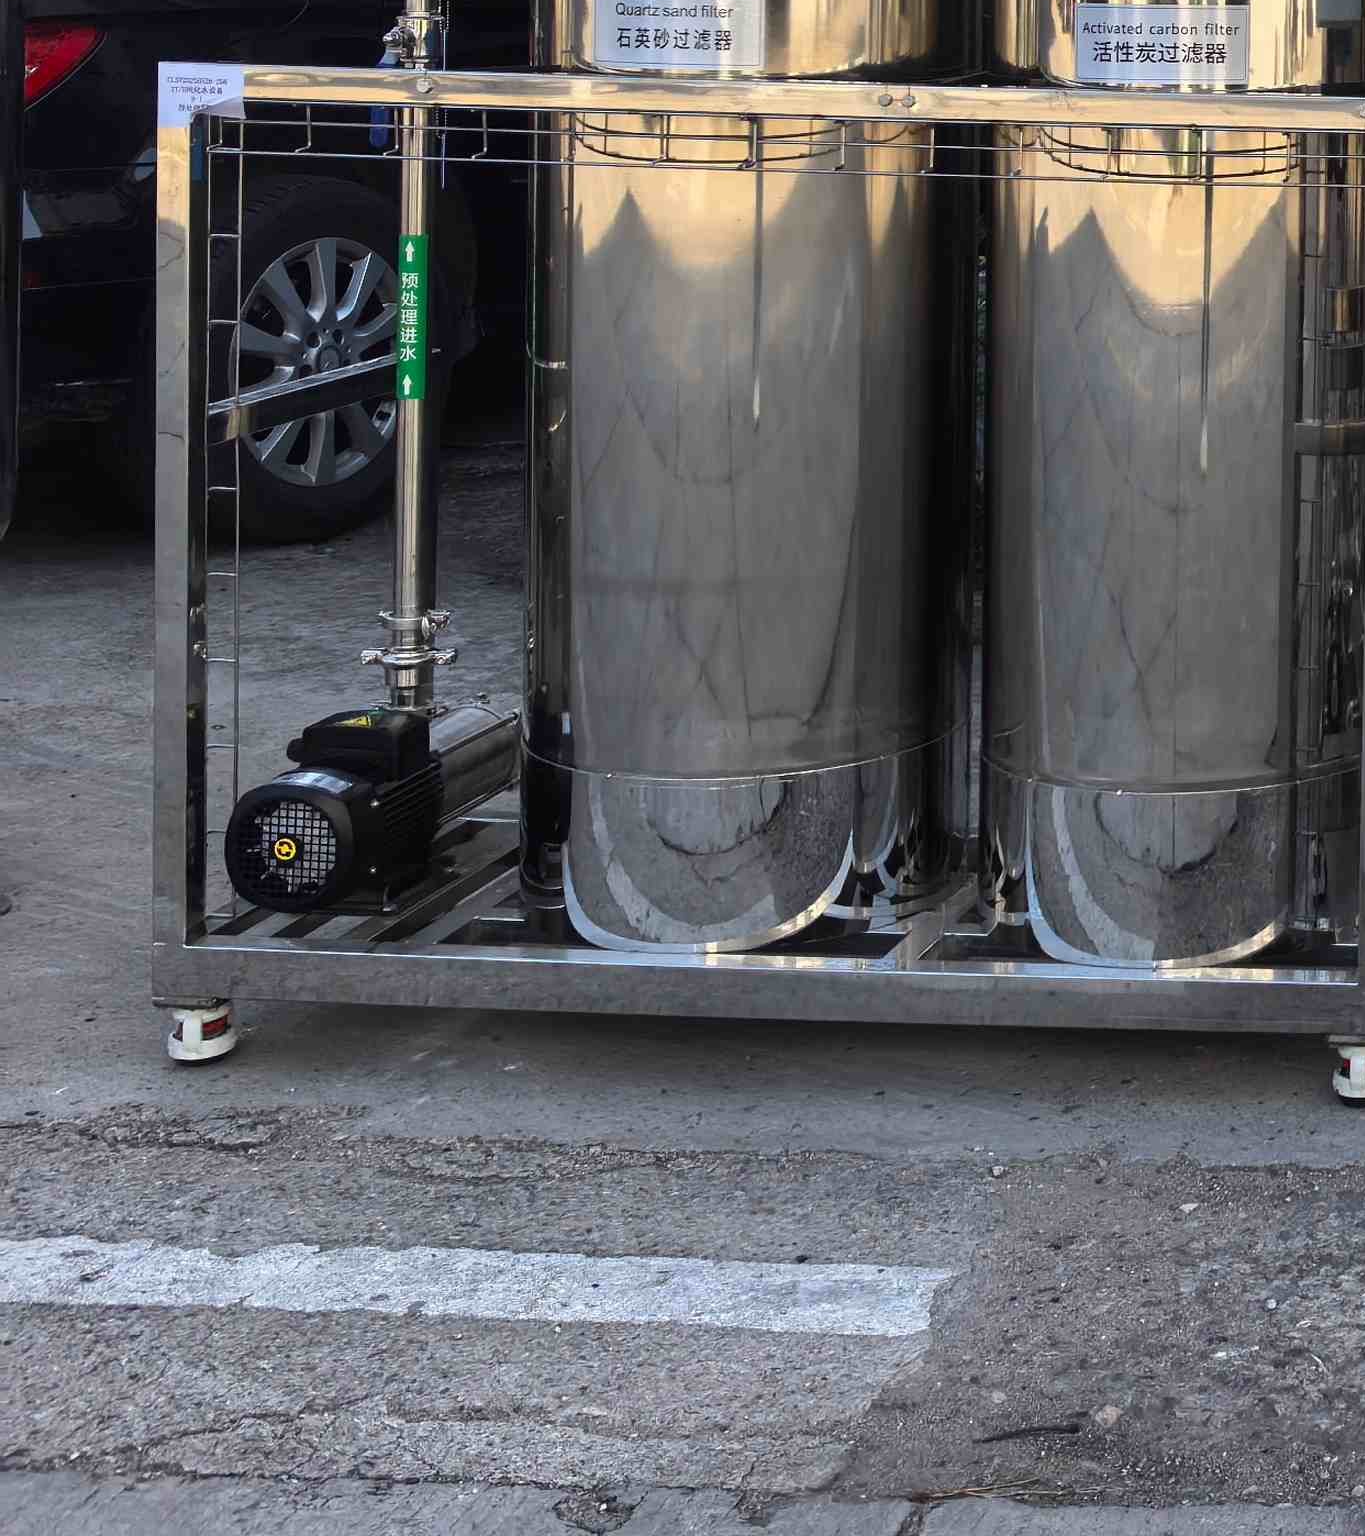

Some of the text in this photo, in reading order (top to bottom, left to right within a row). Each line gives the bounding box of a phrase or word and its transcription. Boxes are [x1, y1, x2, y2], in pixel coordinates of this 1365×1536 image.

[615, 2, 734, 18] Quartz sand filter
[616, 27, 734, 51] 石英砂过滤器
[1082, 21, 1240, 36] Activated carbon filter
[1093, 41, 1228, 65] 活性炭过滤器
[400, 272, 419, 362] 预处理进水
